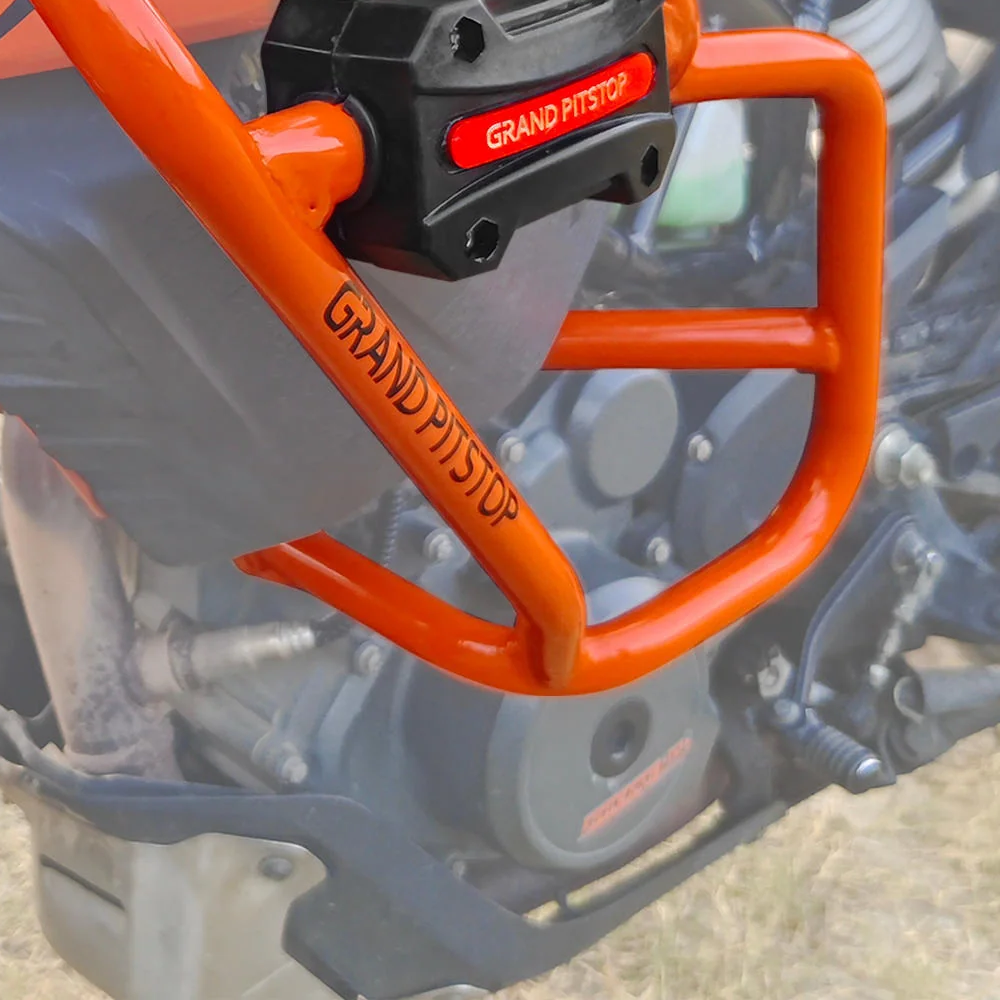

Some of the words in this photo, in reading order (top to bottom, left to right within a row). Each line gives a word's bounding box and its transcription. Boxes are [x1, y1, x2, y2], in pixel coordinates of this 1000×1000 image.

[486, 104, 558, 150] GRAND
[562, 71, 628, 123] PITSTOP
[323, 279, 429, 415] GRAND
[414, 393, 520, 527] PITSTOP
